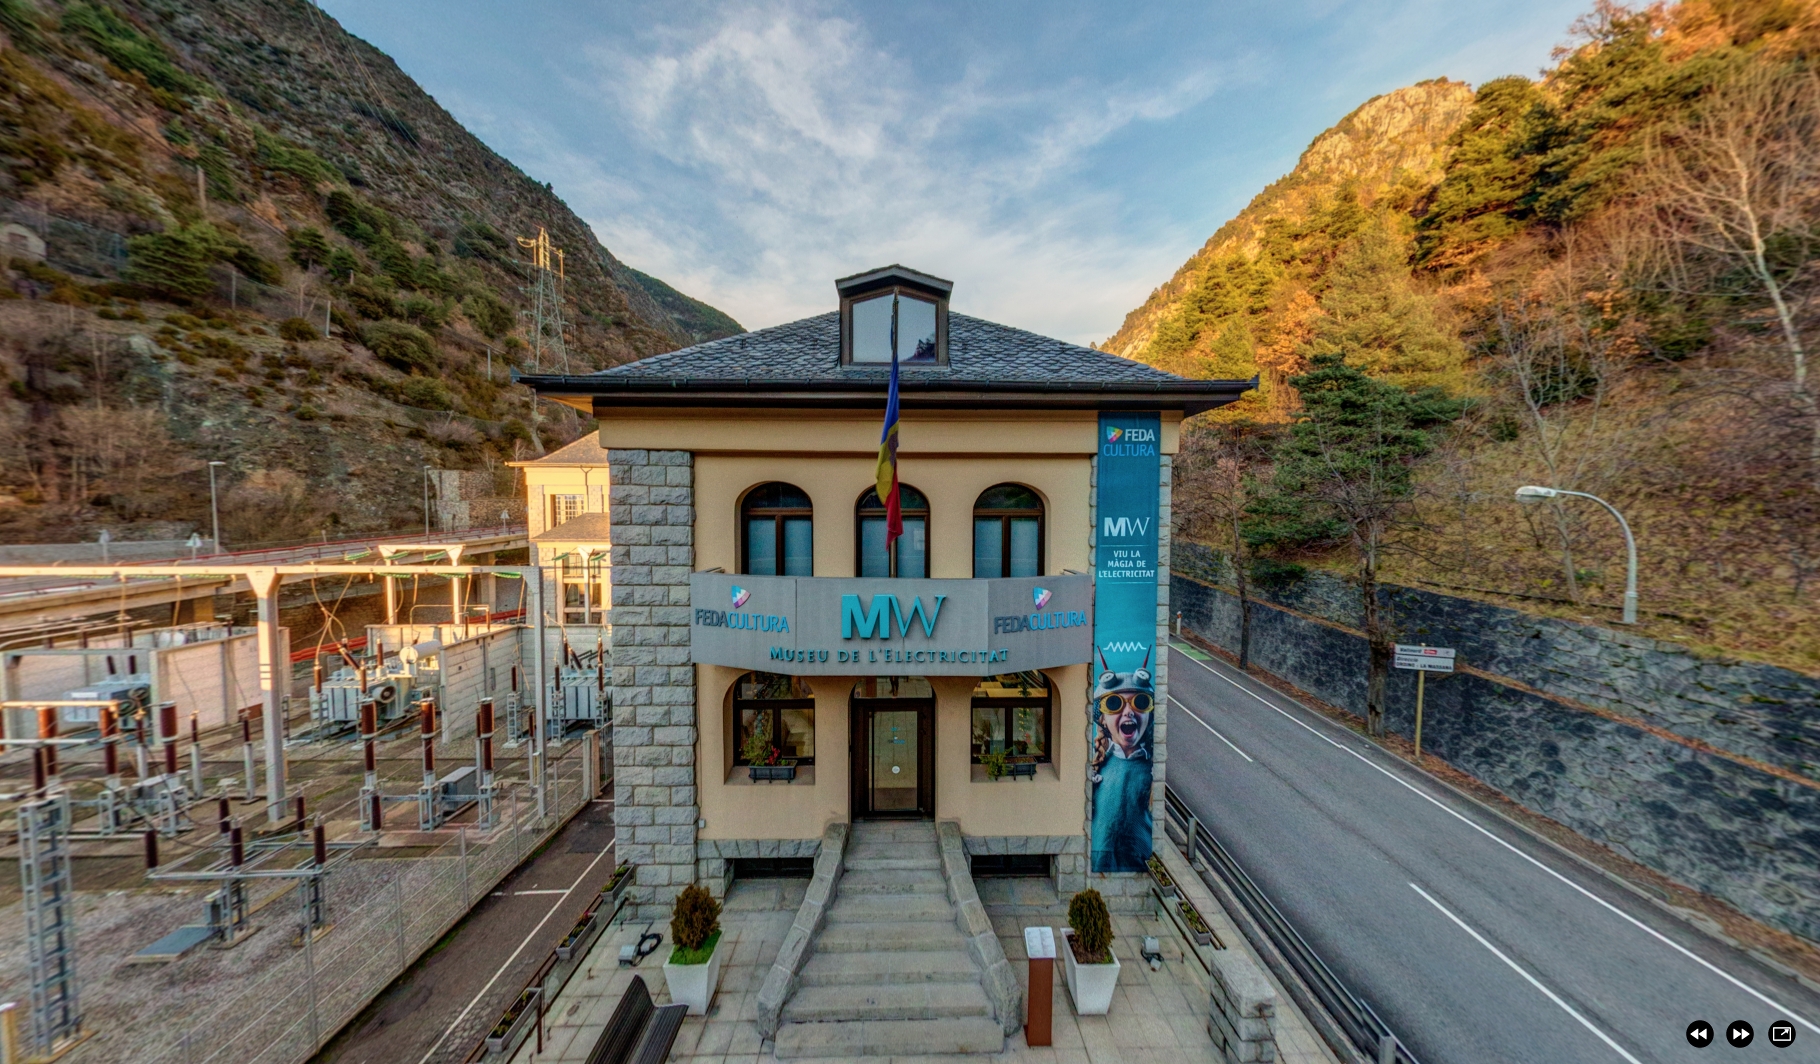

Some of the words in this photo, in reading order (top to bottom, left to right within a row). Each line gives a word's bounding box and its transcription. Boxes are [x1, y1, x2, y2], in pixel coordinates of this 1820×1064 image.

[1124, 428, 1155, 442] FEDA
[1103, 444, 1155, 457] CULTURA
[1104, 517, 1150, 537] MW
[1113, 550, 1128, 558] VIU
[1131, 550, 1141, 558] LA
[1107, 558, 1134, 568] MÀGIA
[1136, 560, 1146, 568] DE
[1098, 570, 1155, 578] L'ELECTRICITAT
[841, 594, 947, 640] MW
[838, 650, 860, 662] DE
